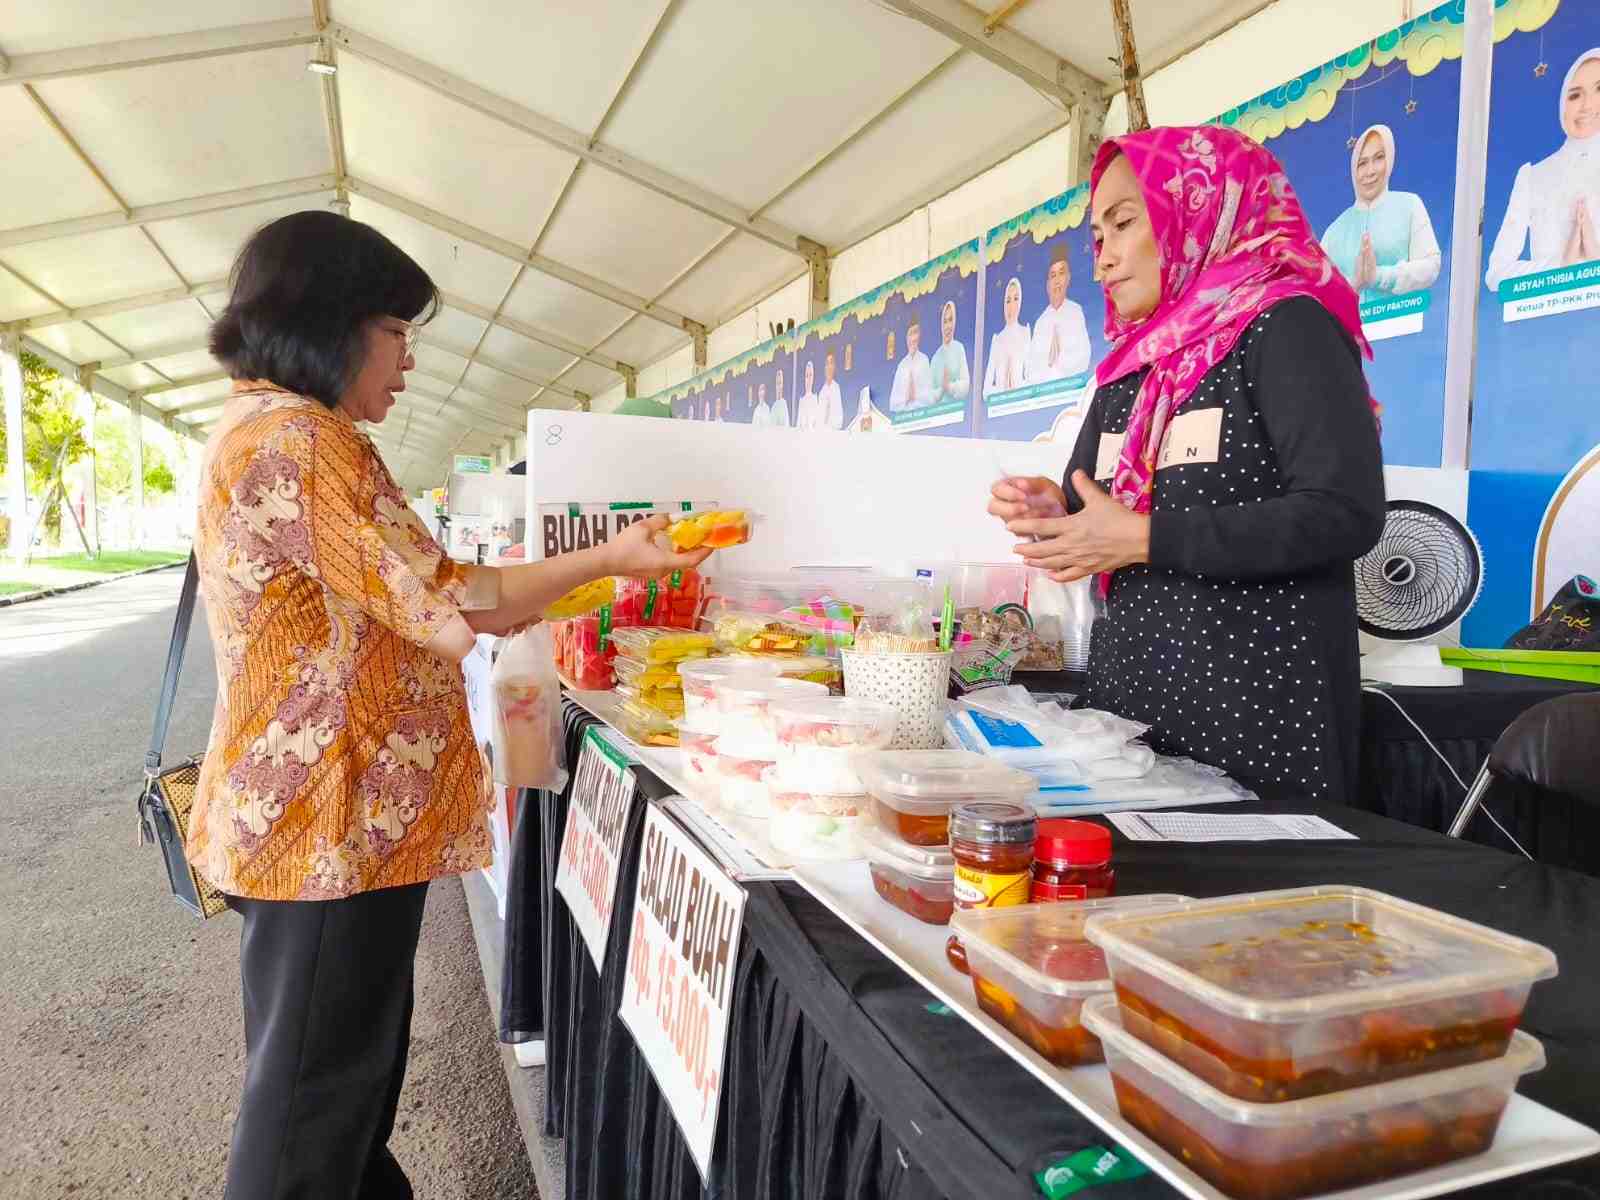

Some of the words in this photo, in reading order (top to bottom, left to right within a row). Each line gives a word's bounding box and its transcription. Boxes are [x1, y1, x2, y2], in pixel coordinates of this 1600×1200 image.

[1513, 278, 1545, 295] AISYAH
[1546, 271, 1575, 286] THISIA
[545, 424, 563, 446] 8
[543, 513, 608, 558] BUAH
[640, 822, 686, 942] SALAD
[682, 866, 736, 1010] BUAH
[630, 911, 651, 1006] Rp.
